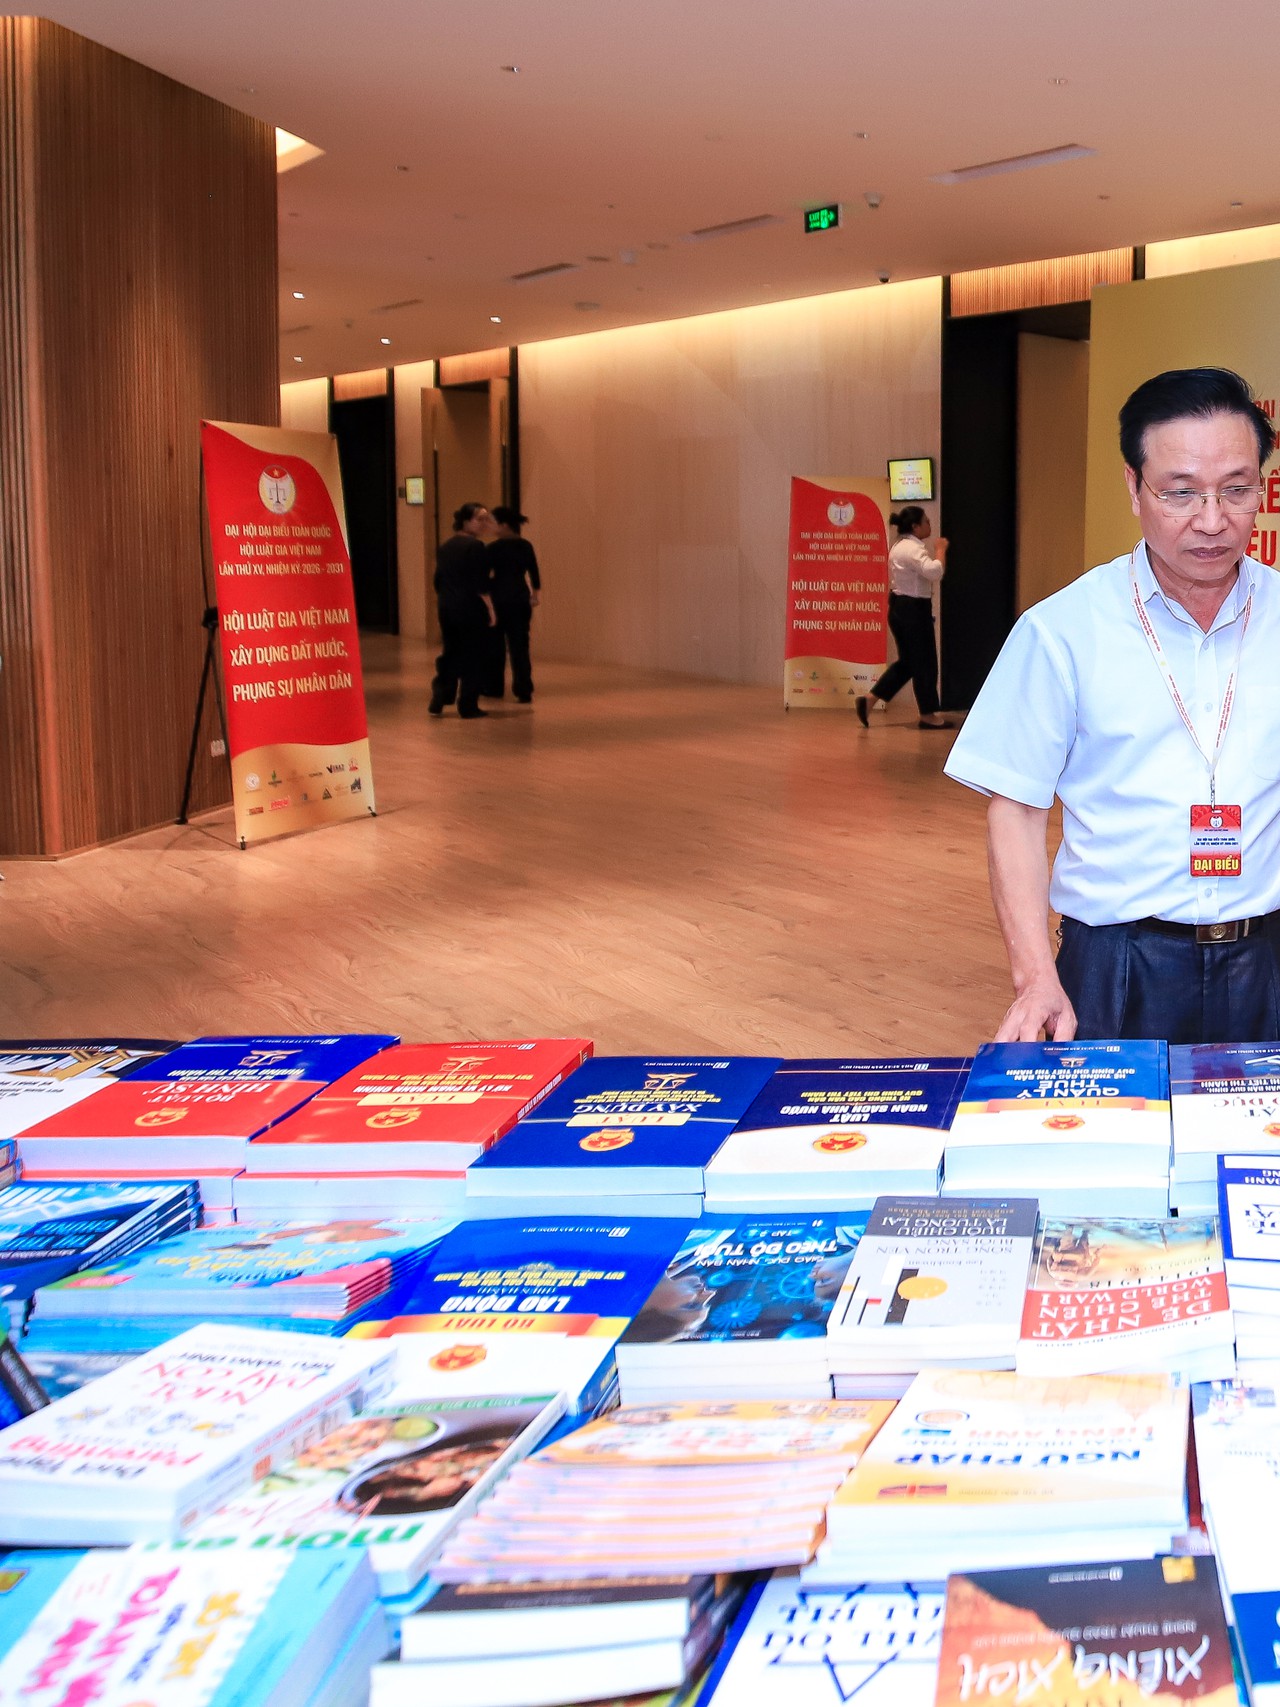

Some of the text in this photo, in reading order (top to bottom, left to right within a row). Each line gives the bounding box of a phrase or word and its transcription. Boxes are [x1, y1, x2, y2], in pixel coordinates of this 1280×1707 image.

[223, 606, 350, 634] HỘI LUẬT GIA VIỆT NAM
[230, 637, 348, 667] XÂY DỰNG ĐẤT NƯỚC,
[232, 669, 352, 703] PHỤNG SỰ NHÂN DÂN
[1194, 854, 1240, 873] ĐẠI BIỂU
[829, 1112, 870, 1124] LUẬT
[1121, 1276, 1212, 1299] WORLD
[439, 1293, 571, 1313] LAO ĐỘNG
[1040, 1293, 1051, 1306] I
[1058, 1291, 1112, 1305] WAR
